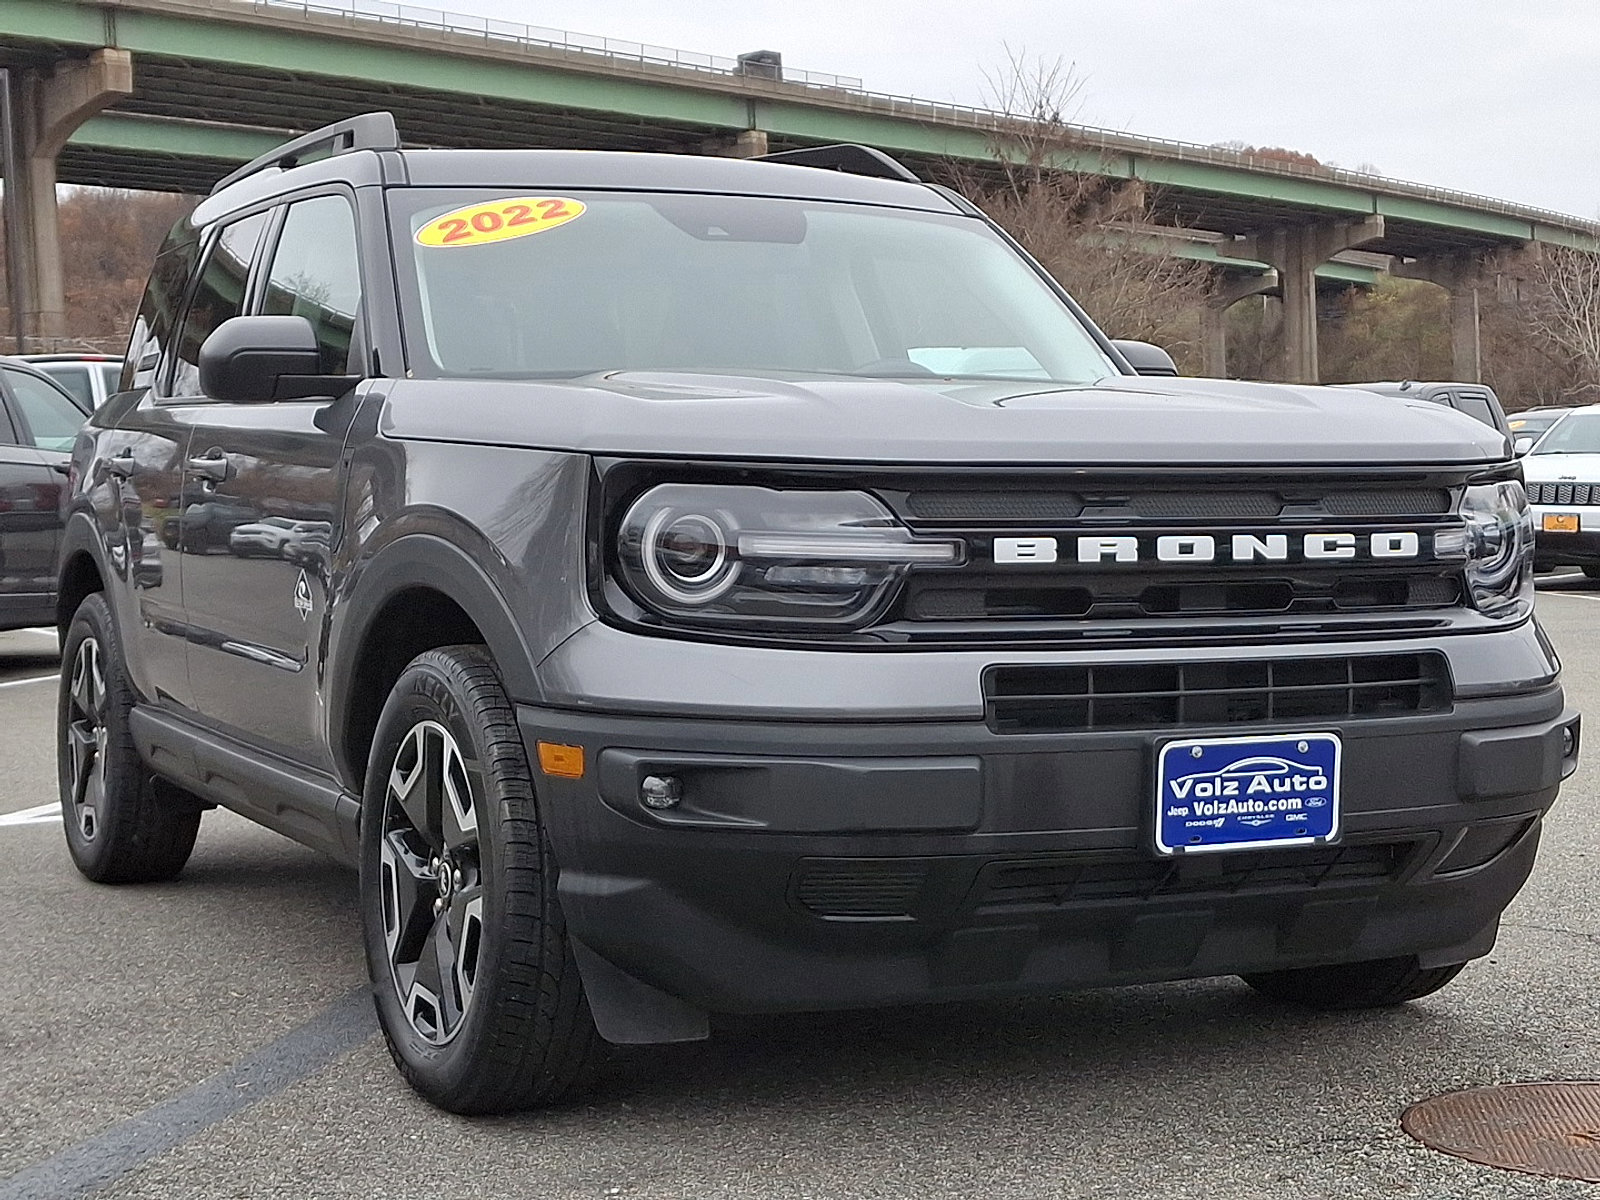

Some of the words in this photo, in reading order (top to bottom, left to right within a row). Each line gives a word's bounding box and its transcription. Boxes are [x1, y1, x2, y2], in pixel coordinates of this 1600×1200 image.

[438, 199, 571, 243] 2022
[993, 532, 1419, 564] BRONCO
[414, 675, 460, 719] KELLY
[1169, 776, 1240, 799] Volz
[1246, 774, 1328, 794] Auto
[1167, 805, 1189, 817] Jeep
[1193, 797, 1302, 816] VolzAuto.com
[1285, 813, 1308, 822] GMC
